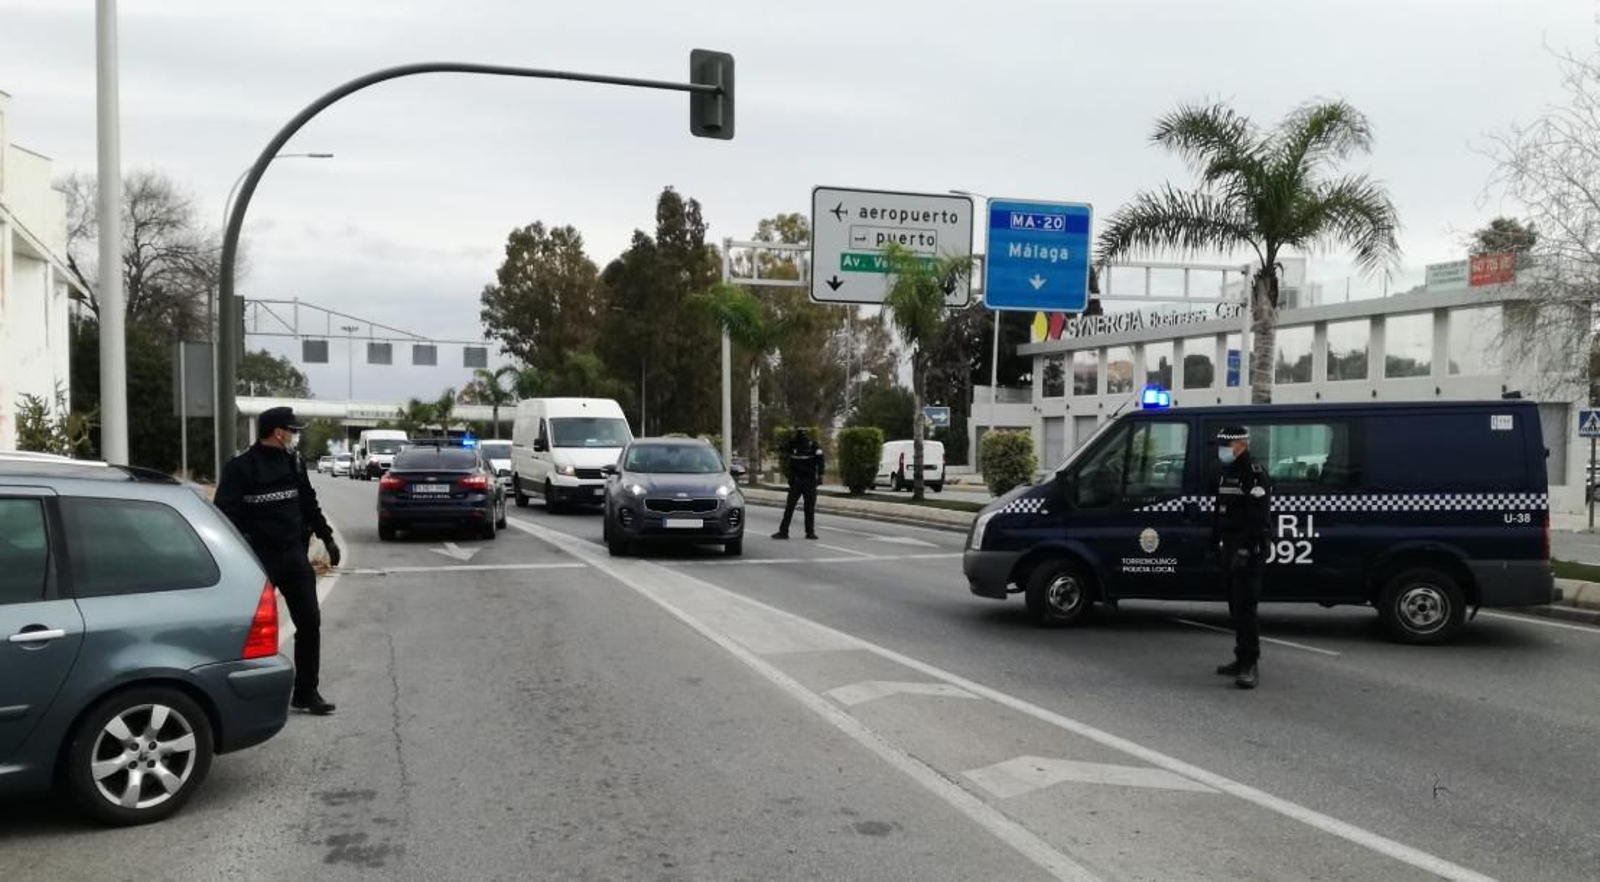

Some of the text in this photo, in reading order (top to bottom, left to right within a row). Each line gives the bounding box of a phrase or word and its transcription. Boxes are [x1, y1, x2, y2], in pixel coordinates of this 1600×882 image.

[858, 204, 959, 225] aeropuerto
[1012, 213, 1064, 230] MA-20
[876, 231, 935, 247] puerto
[1009, 242, 1069, 262] Málaga
[842, 255, 866, 268] Av.
[1067, 309, 1144, 338] SYNERGIA
[1215, 302, 1245, 319] Cen
[1504, 513, 1531, 523] U-38
